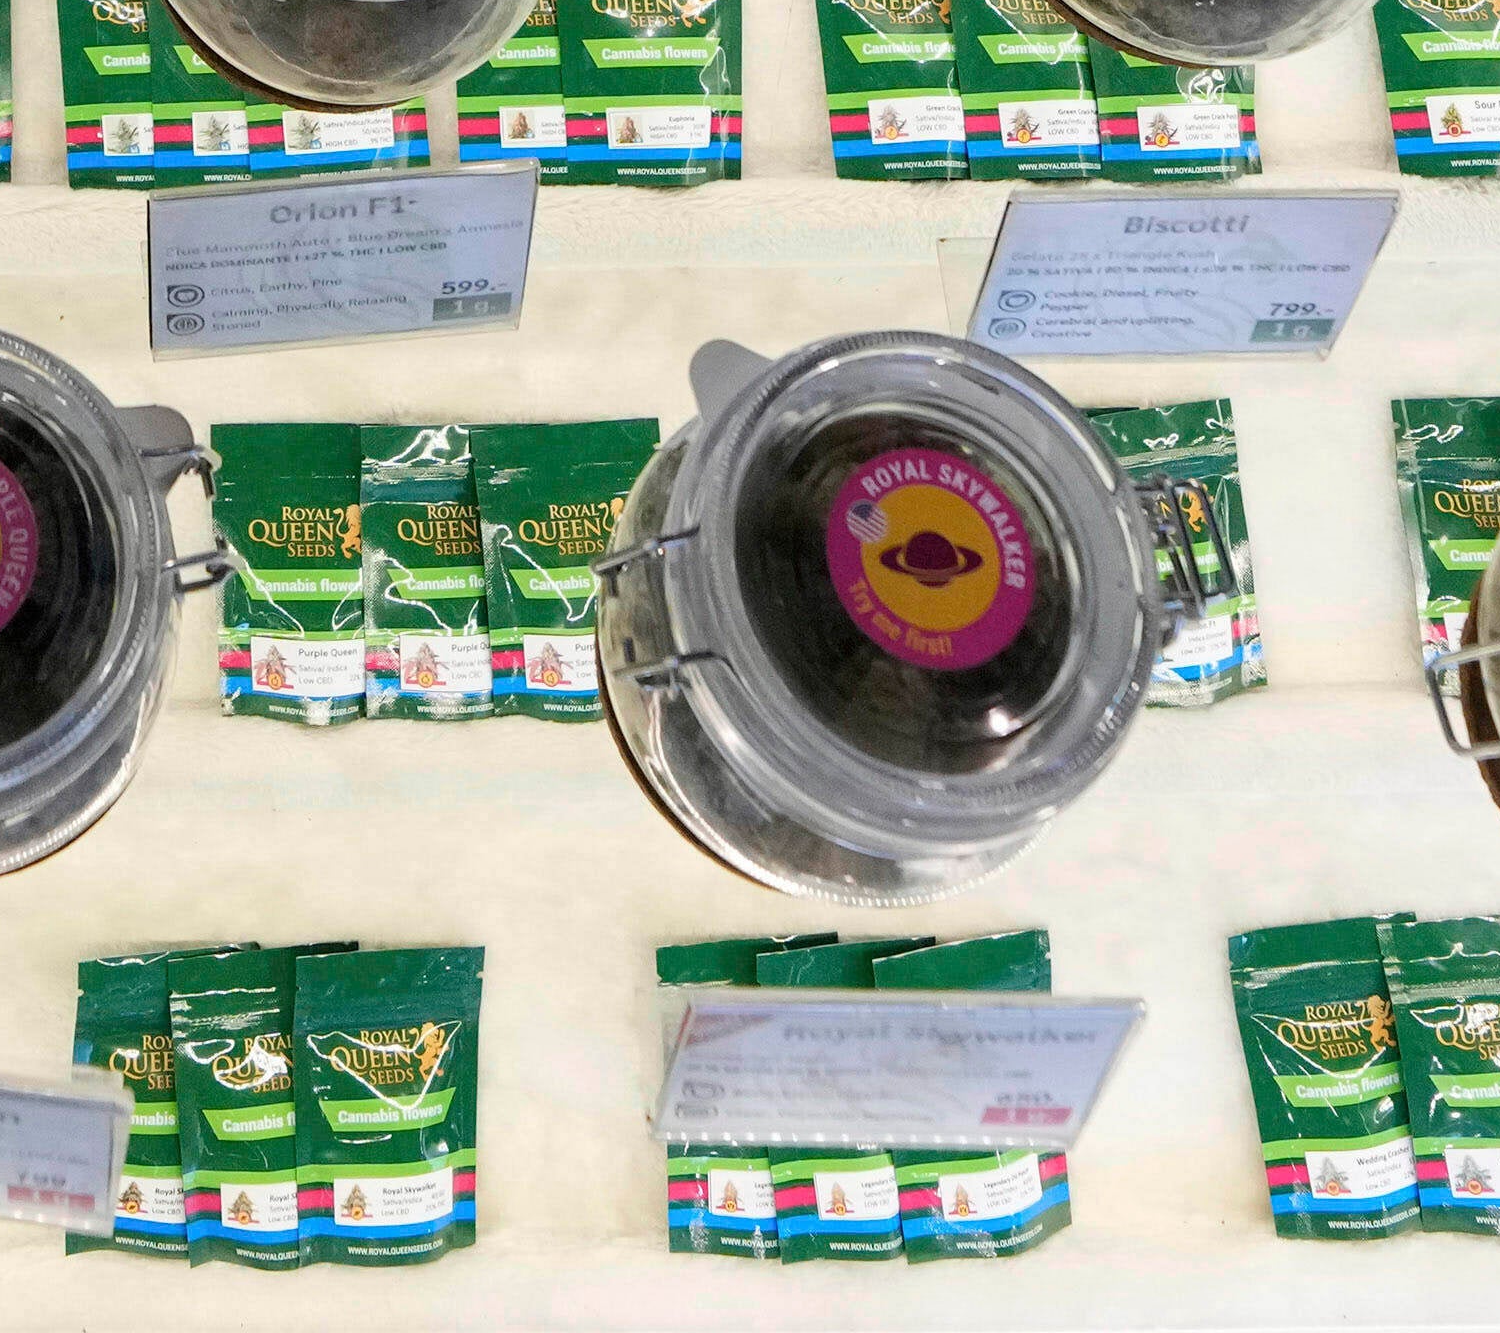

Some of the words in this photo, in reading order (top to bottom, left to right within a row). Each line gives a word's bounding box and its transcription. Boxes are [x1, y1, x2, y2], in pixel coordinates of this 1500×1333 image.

[630, 14, 677, 28] SEEDS
[888, 10, 934, 25] SEEDS
[1443, 8, 1489, 22] SEEDS
[497, 45, 556, 60] Cannabis
[601, 47, 662, 61] Cannabis
[664, 45, 709, 59] flowers
[861, 42, 921, 56] Cannabis
[1474, 99, 1496, 109] Sour
[270, 198, 358, 224] Orion
[1124, 214, 1251, 235] Biscotti
[441, 278, 509, 295] 599.-
[281, 506, 334, 521] ROYAL
[426, 504, 477, 519] ROYAL
[548, 504, 600, 519] ROYAL
[248, 519, 335, 547] QUEEN
[397, 518, 481, 547] QUEEN
[519, 518, 602, 546] QUEEN
[861, 459, 934, 498] ROYAL
[938, 463, 1026, 590] SKYWALKER
[287, 541, 335, 558] SEEDS
[435, 540, 481, 556] SEEDS
[255, 578, 317, 592] Cannabis
[529, 576, 591, 591] Cannabis
[298, 648, 329, 659] Purple
[331, 647, 358, 658] Queen
[1304, 1003, 1357, 1021] ROYAL
[360, 1029, 411, 1047] ROYAL
[1277, 1018, 1359, 1049] QUEEN
[1320, 1041, 1368, 1059] SEEDS
[330, 1045, 411, 1073] QUEEN
[368, 1068, 415, 1086] SEEDS
[1296, 1082, 1359, 1099] Cannabis
[337, 1109, 400, 1125] Cannabis
[402, 1103, 443, 1121] flowers
[222, 1116, 282, 1133] Cannabis
[1356, 1155, 1387, 1167] Wedding
[382, 1187, 403, 1196] Royal
